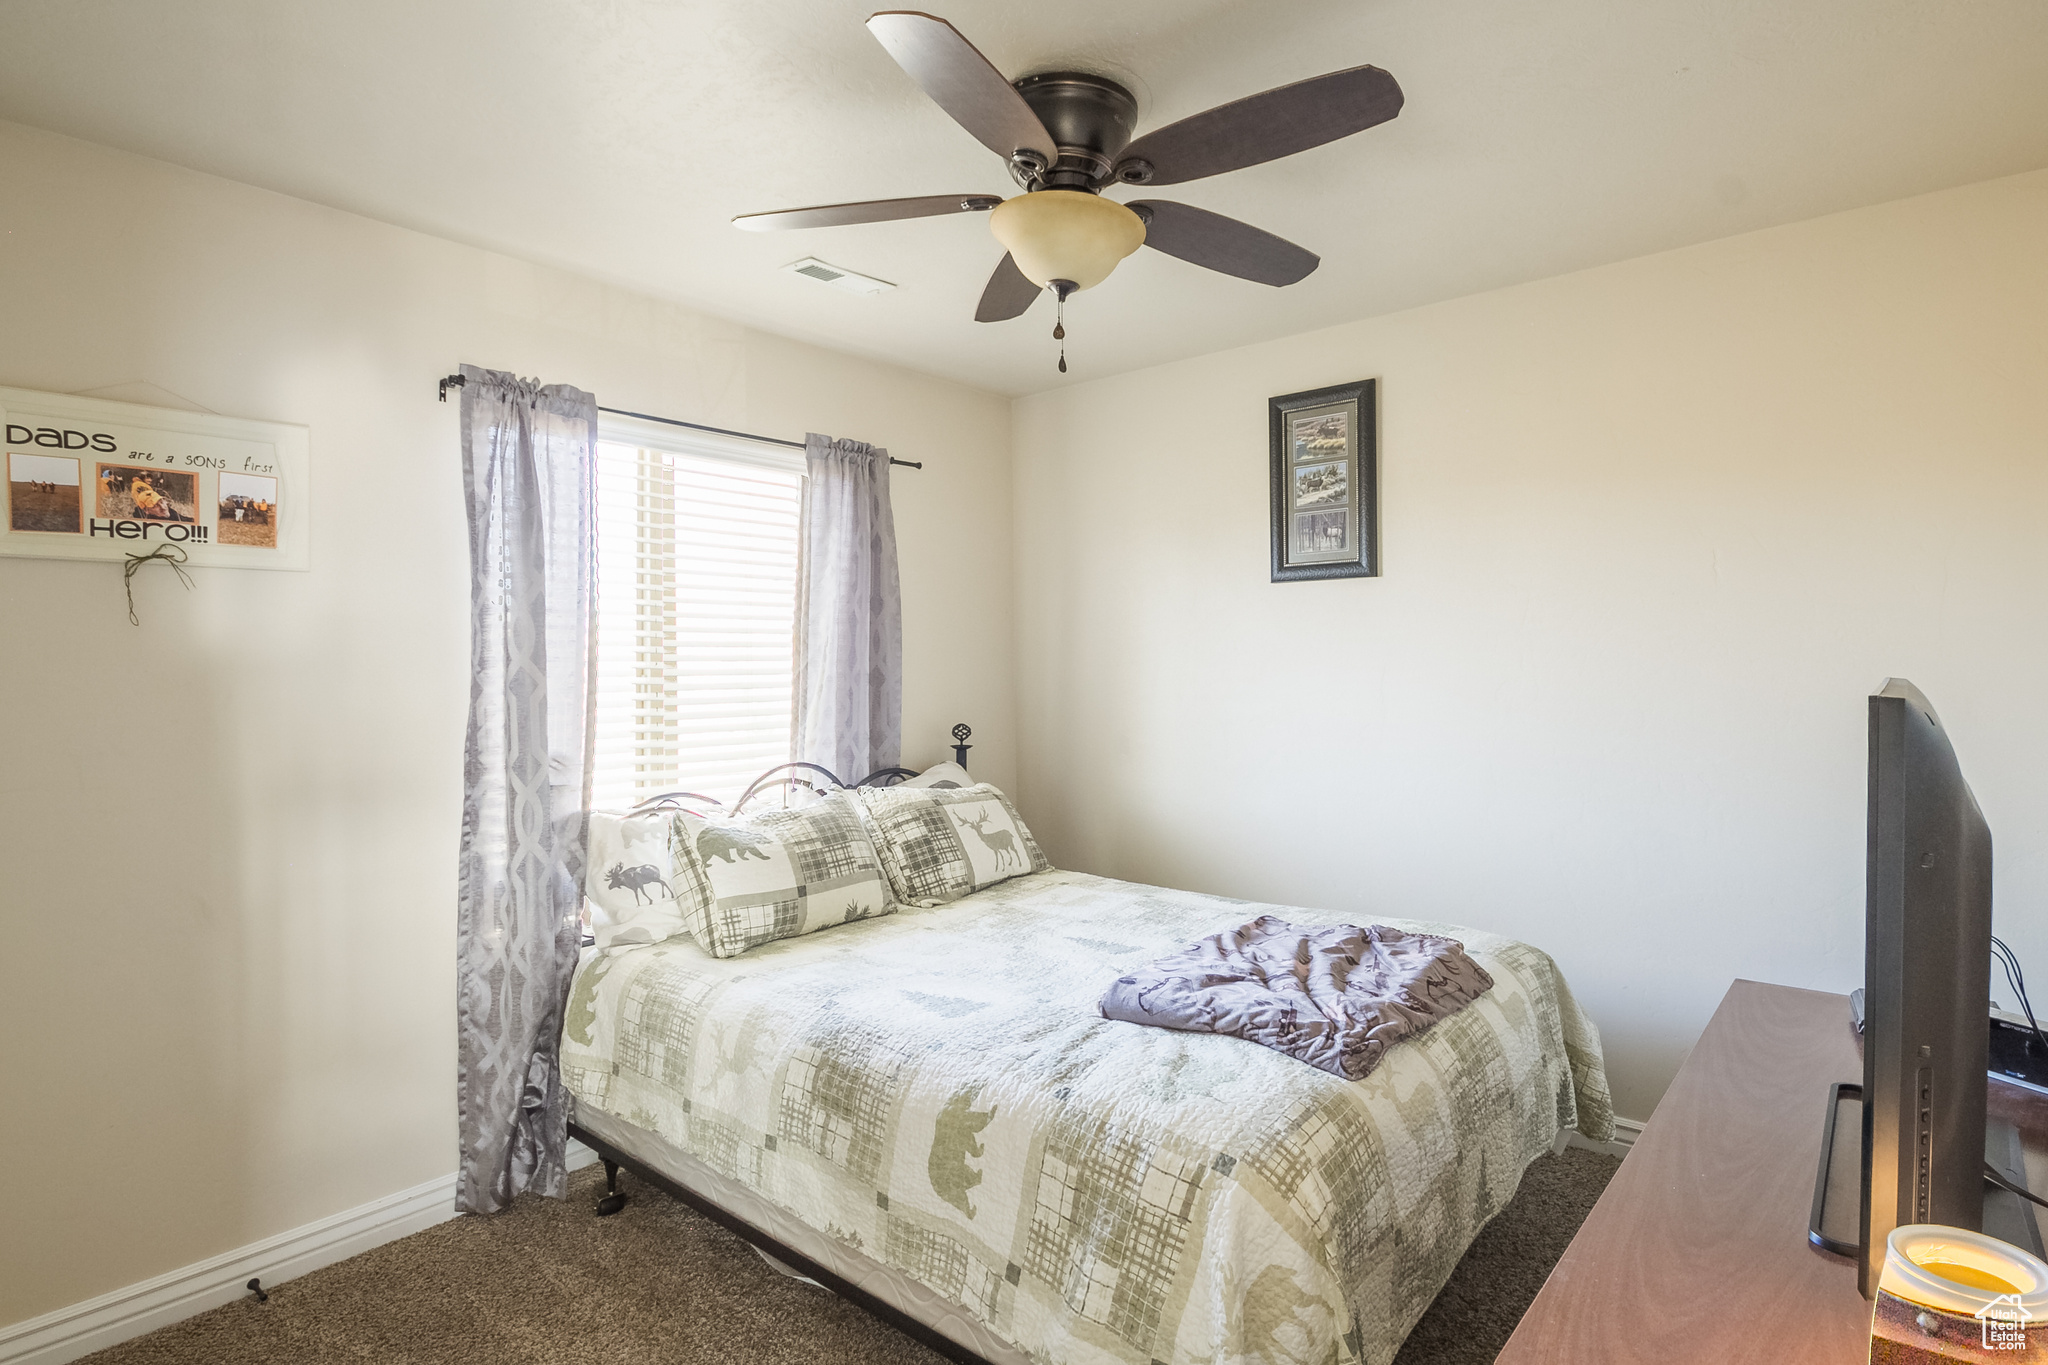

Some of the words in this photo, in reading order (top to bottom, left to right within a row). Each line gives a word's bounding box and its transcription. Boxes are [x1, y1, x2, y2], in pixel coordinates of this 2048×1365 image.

[128, 450, 155, 461] are
[165, 455, 174, 463] a
[185, 455, 226, 469] SONS
[244, 456, 273, 473] first
[89, 518, 209, 544] Hero!!!
